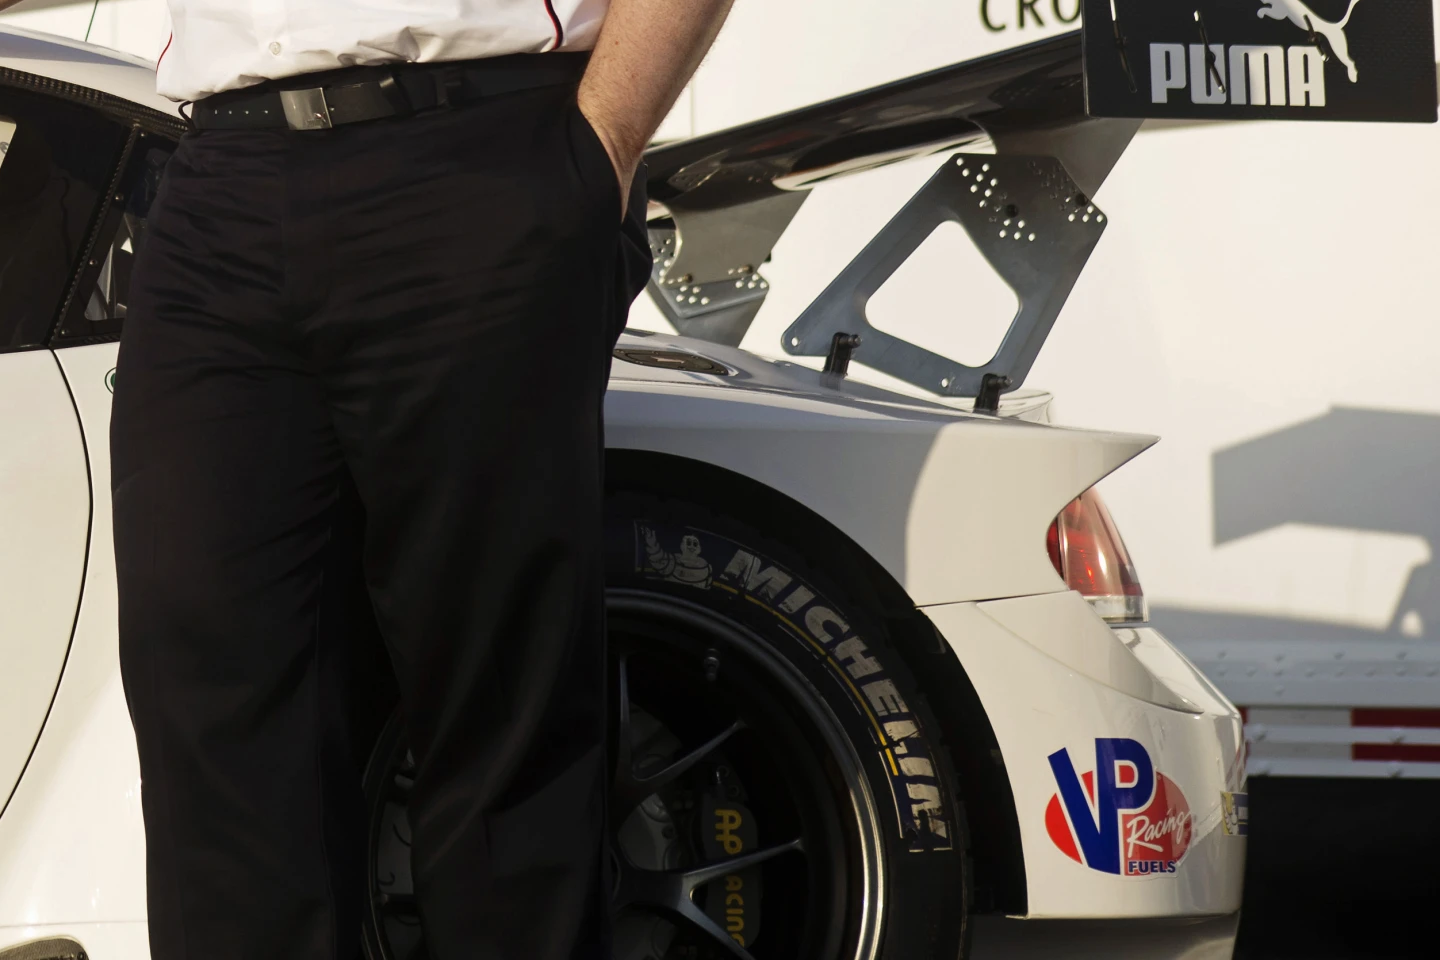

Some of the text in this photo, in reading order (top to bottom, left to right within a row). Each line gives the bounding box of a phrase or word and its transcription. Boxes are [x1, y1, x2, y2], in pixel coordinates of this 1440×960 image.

[1149, 42, 1326, 107] PUMA
[721, 549, 948, 839] MICHELIN
[715, 809, 743, 854] AP
[1047, 737, 1155, 876] VP
[1126, 808, 1192, 859] Racing
[1128, 861, 1176, 873] FUELS
